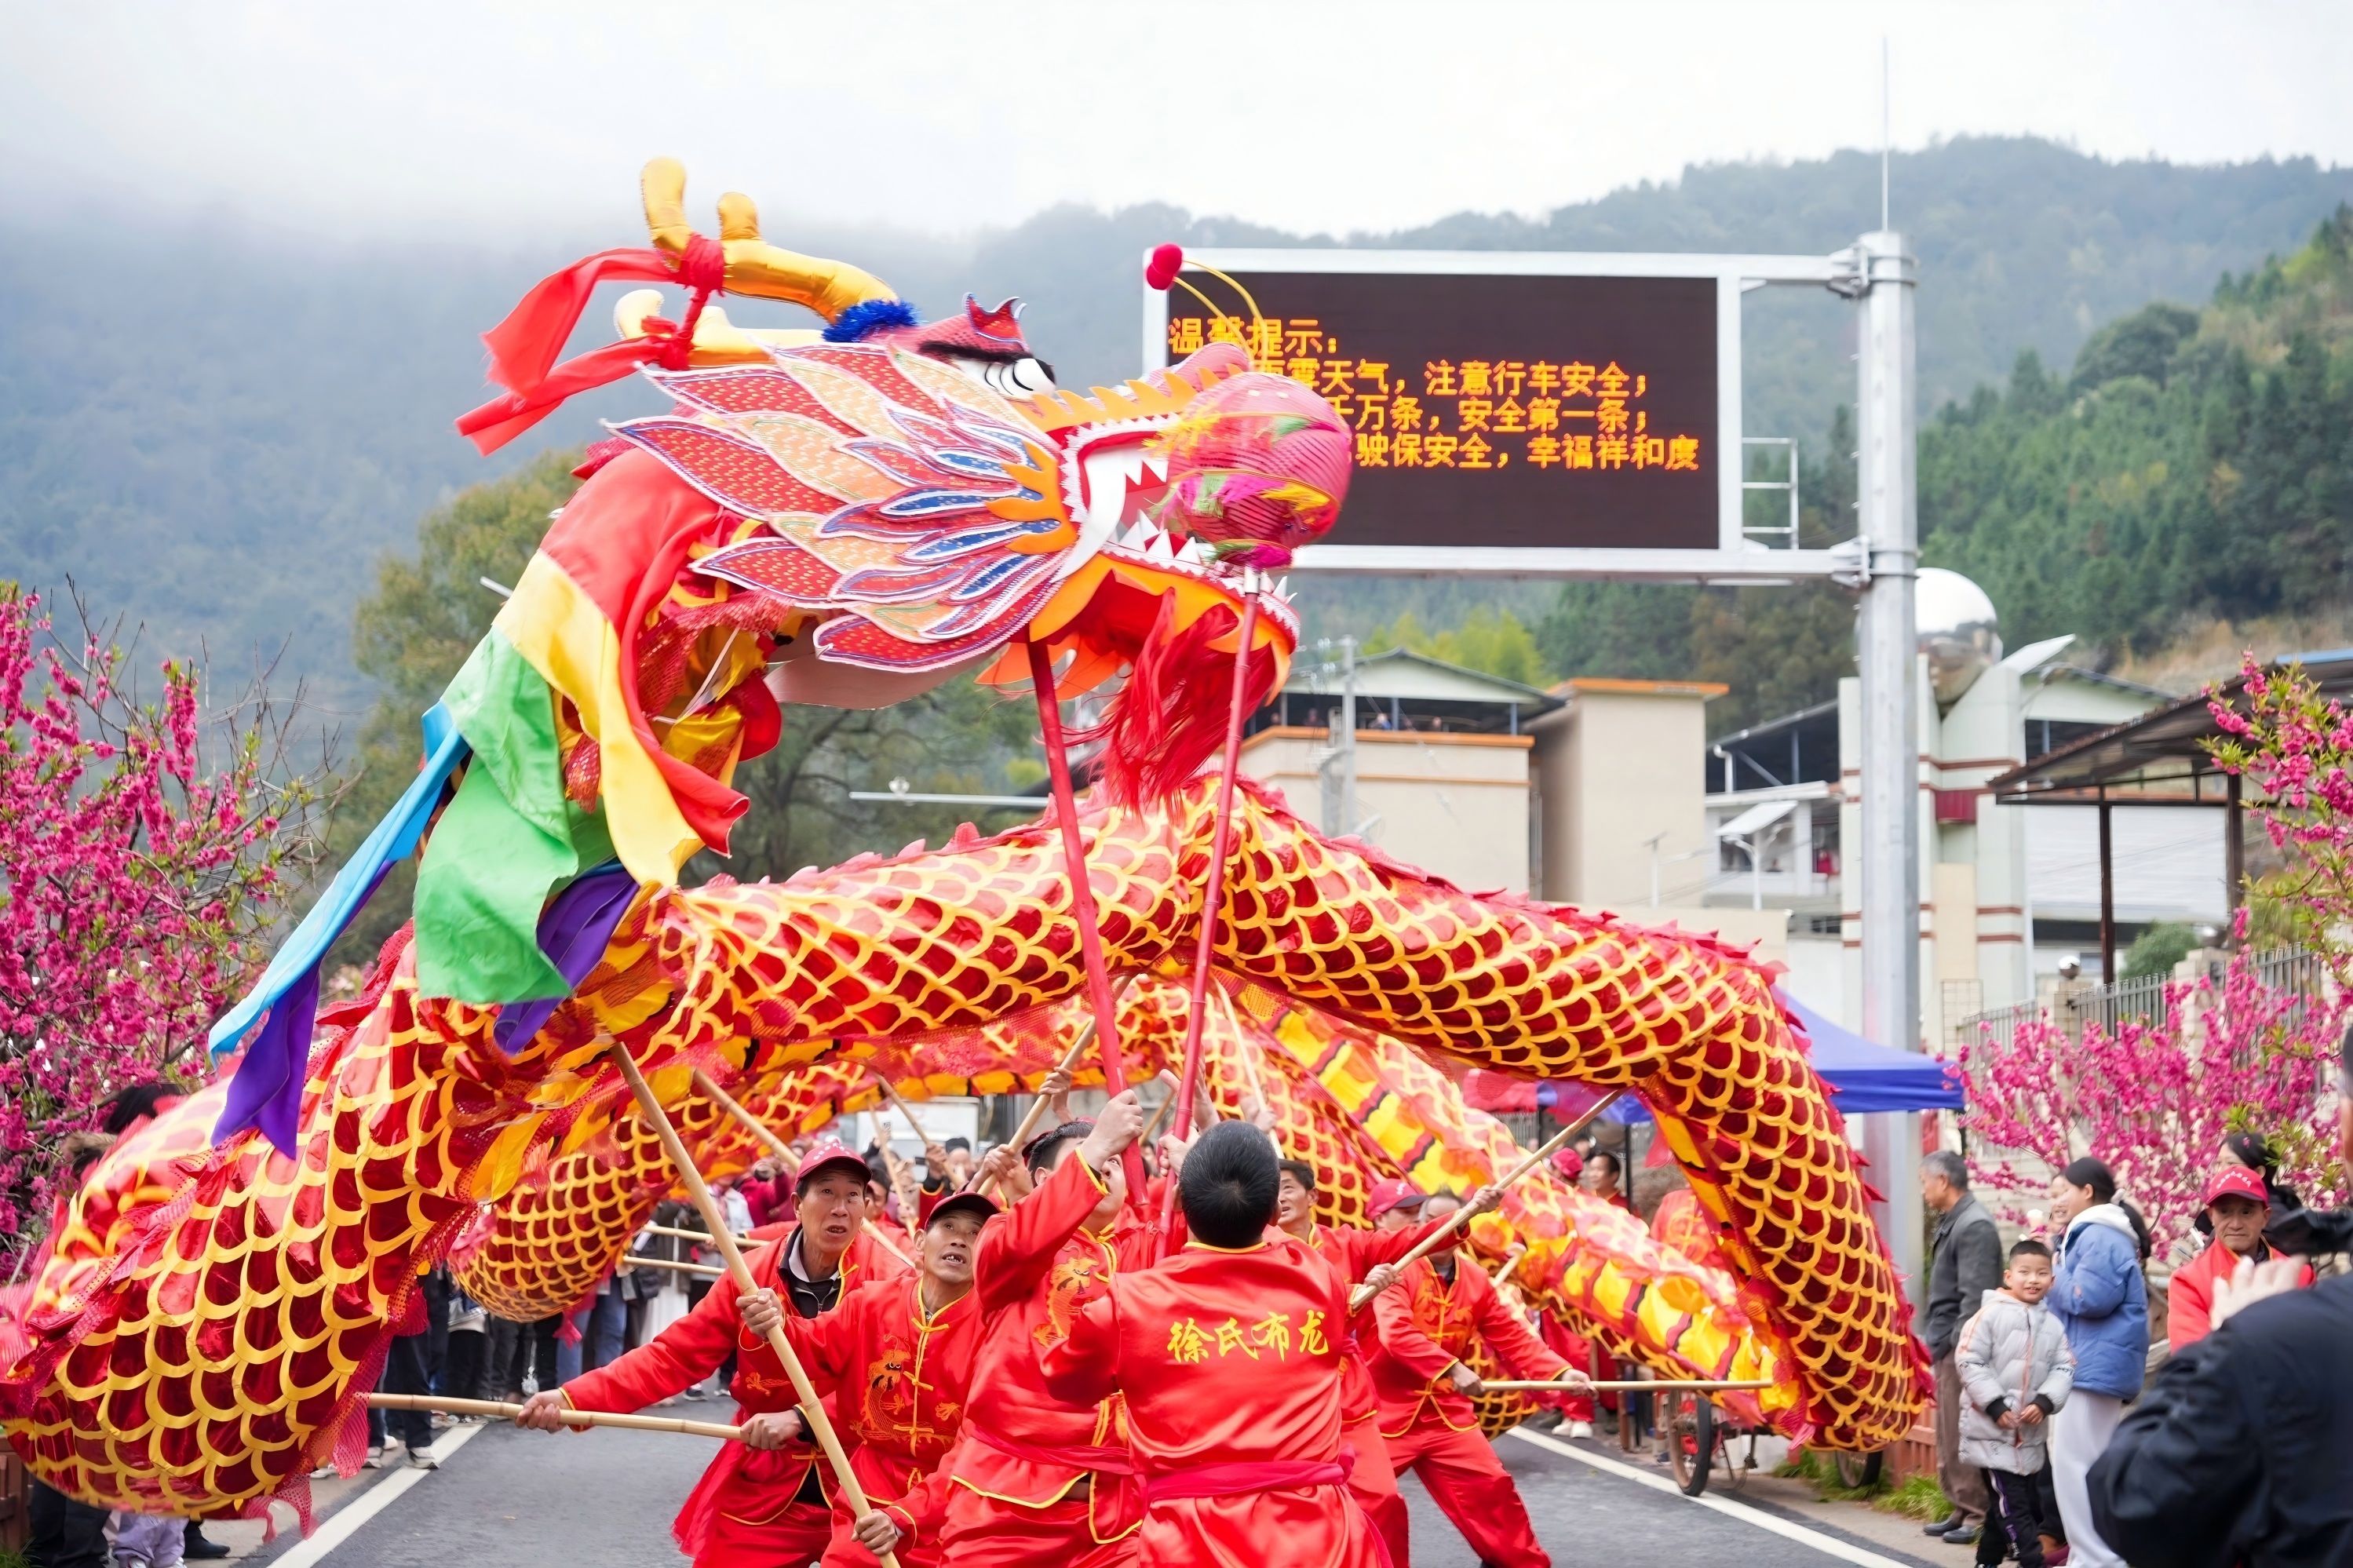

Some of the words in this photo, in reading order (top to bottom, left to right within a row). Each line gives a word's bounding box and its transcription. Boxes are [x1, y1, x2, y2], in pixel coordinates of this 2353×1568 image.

[1348, 431, 1700, 471] 驶保安全，幸福祥和度
[1166, 1308, 1330, 1364] 徐氏布龙
